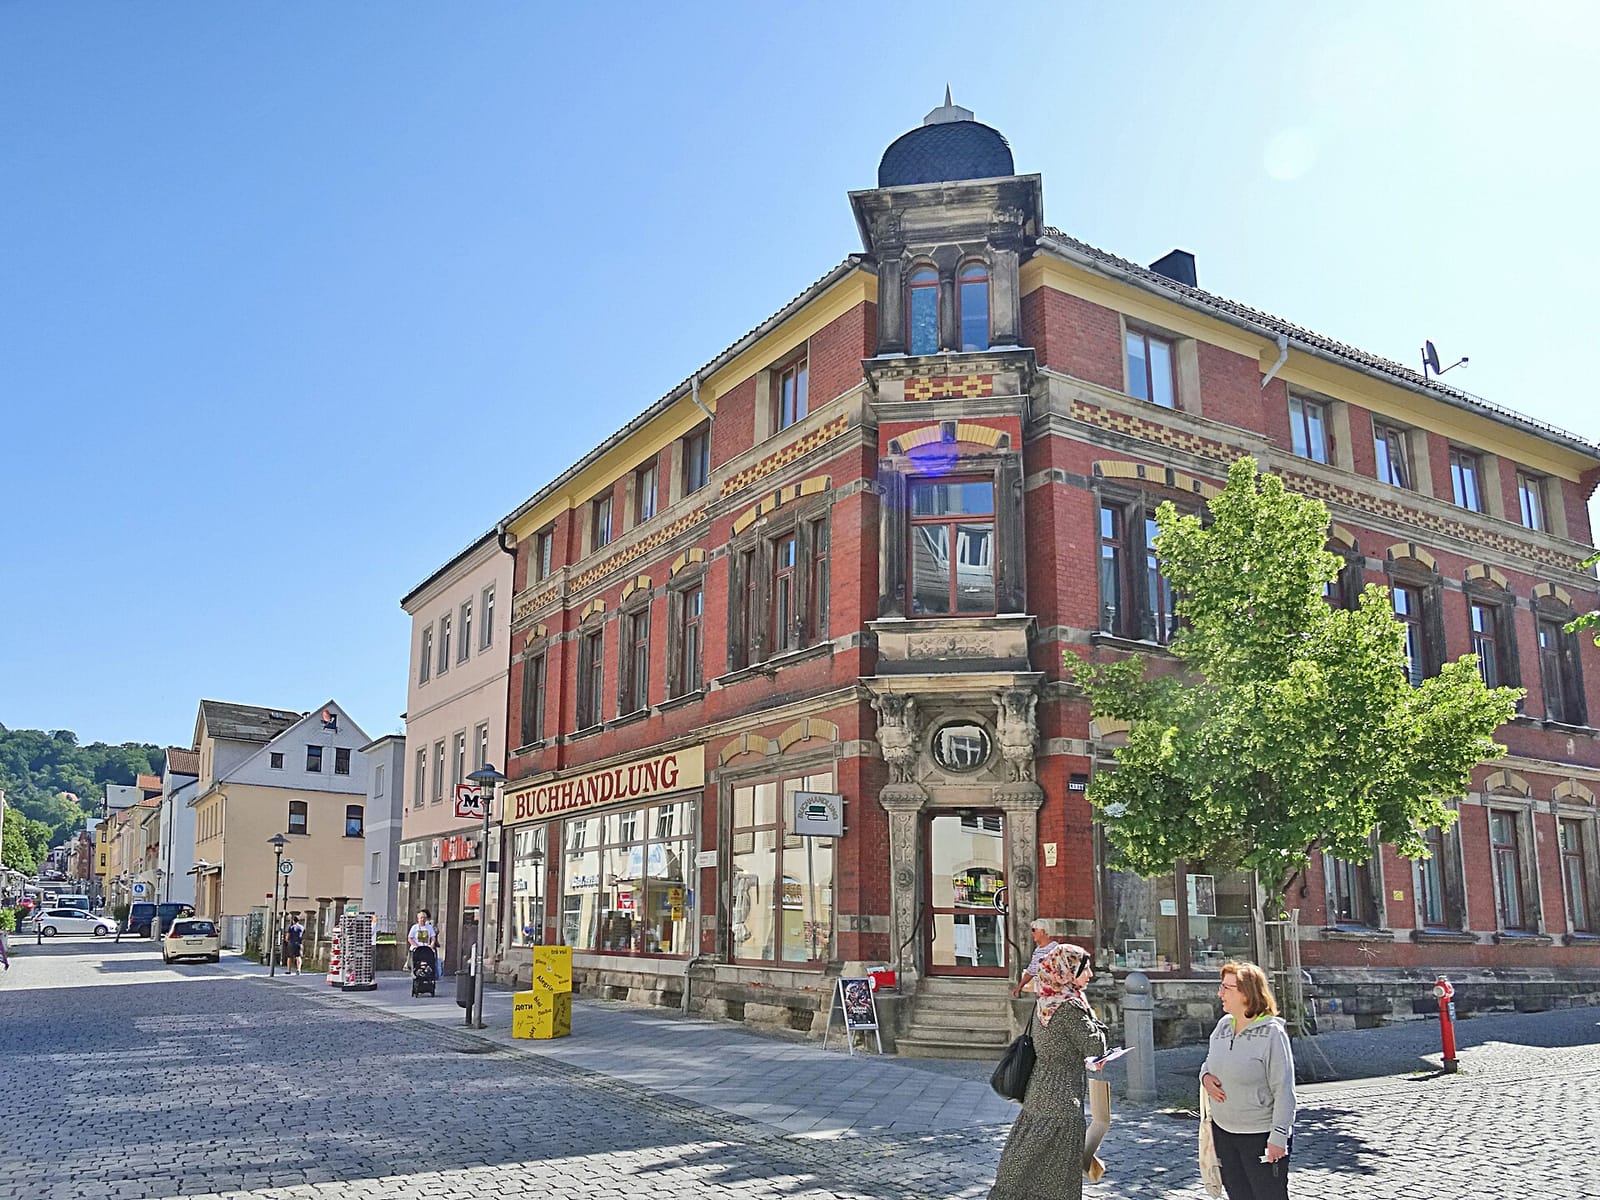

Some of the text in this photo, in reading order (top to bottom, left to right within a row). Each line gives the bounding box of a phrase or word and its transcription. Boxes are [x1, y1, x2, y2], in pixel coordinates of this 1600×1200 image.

[515, 755, 679, 819] BUCHHANDLUNG
[463, 794, 480, 808] M
[798, 796, 839, 820] BUCHHANDLUNG
